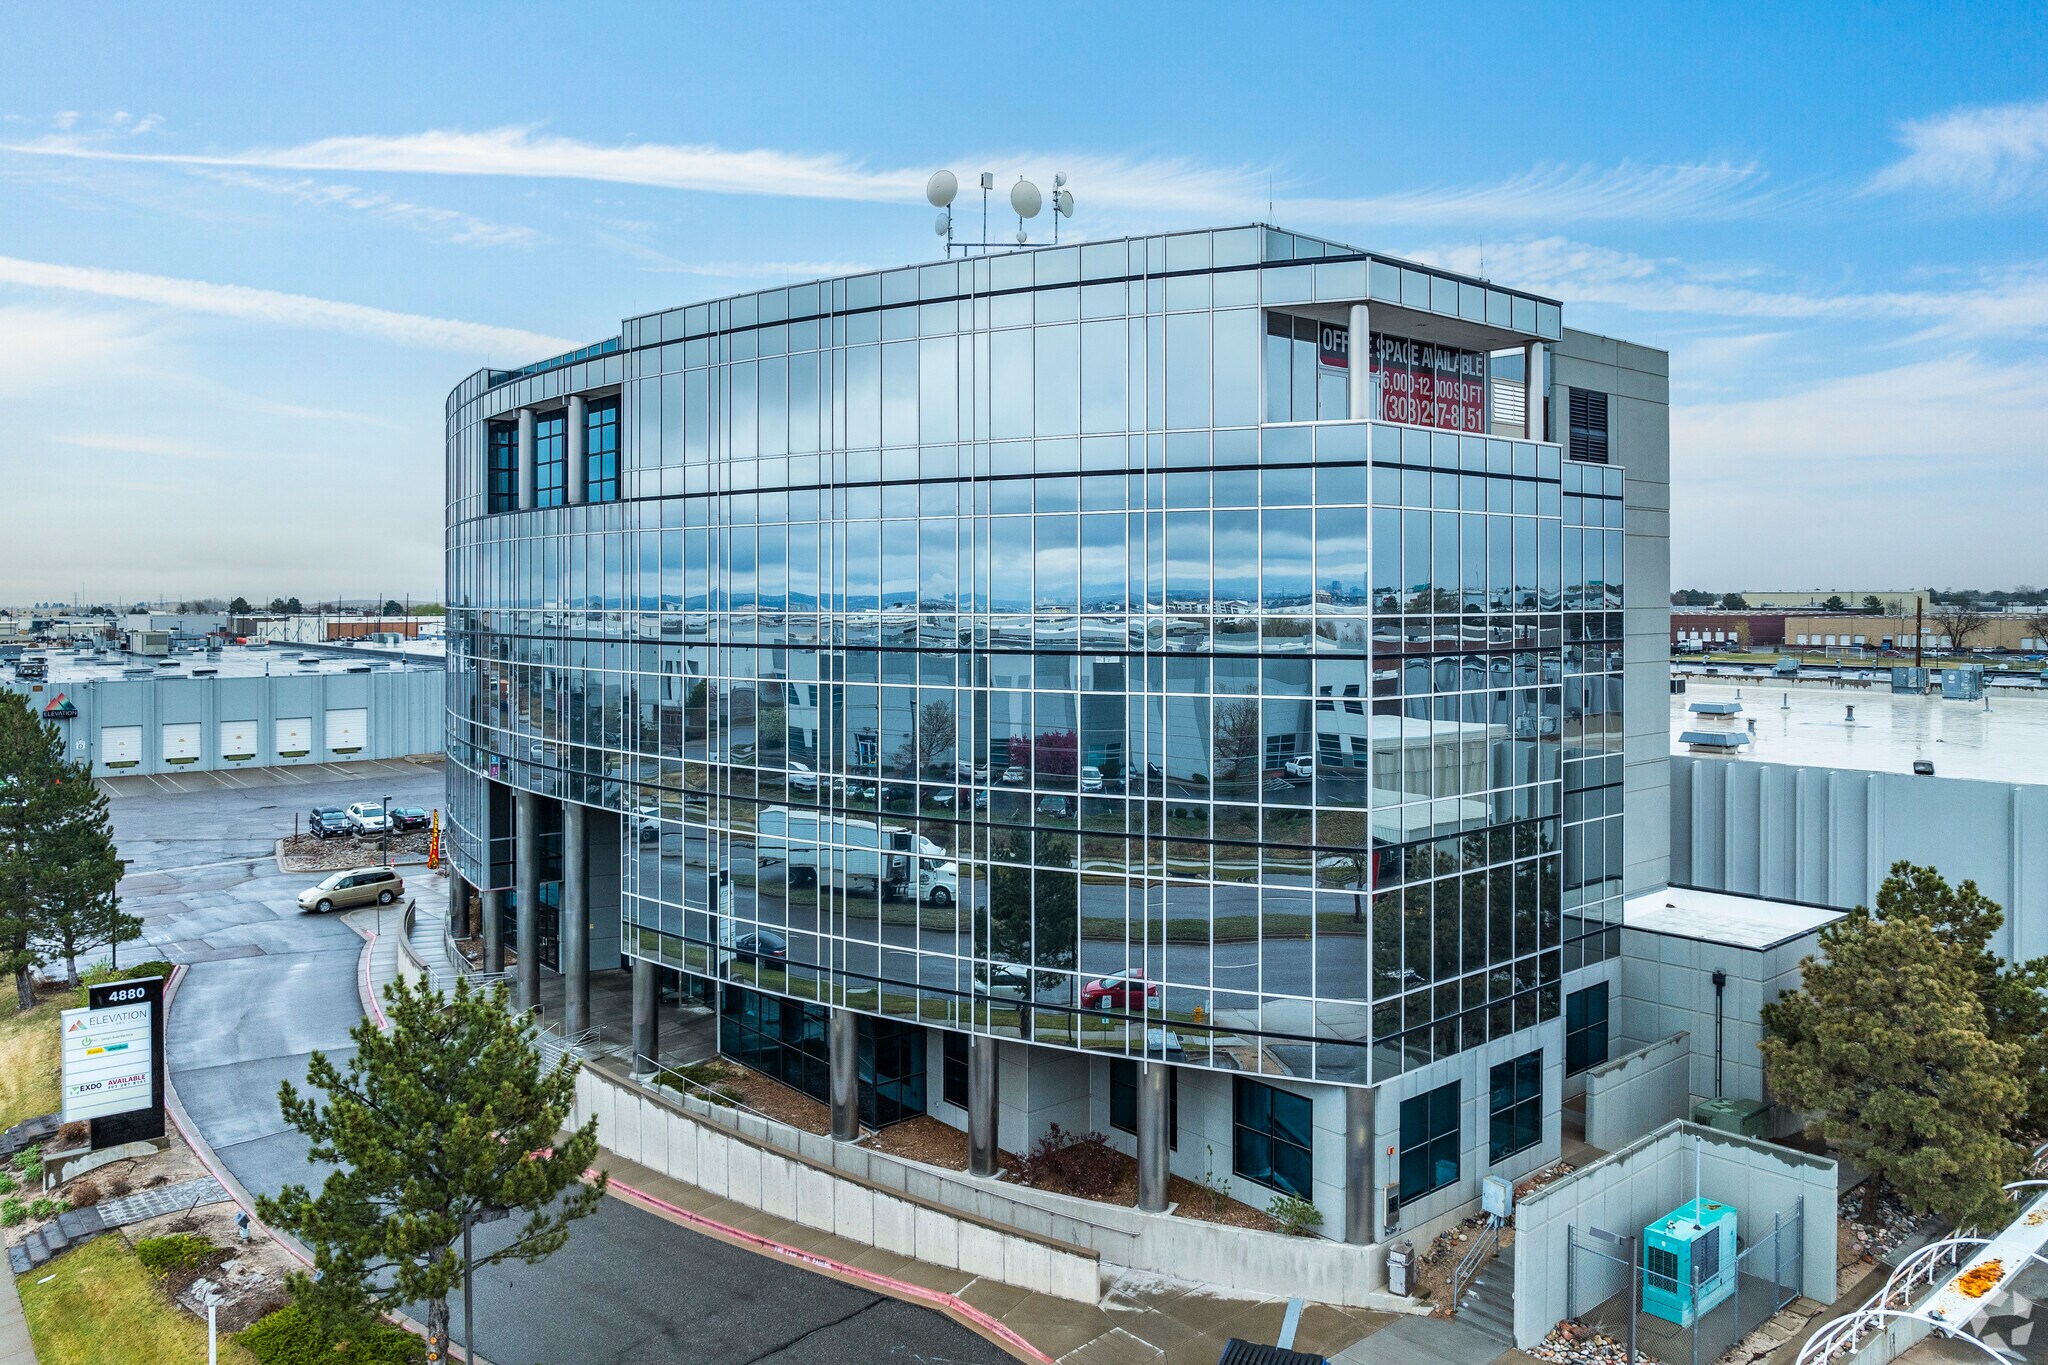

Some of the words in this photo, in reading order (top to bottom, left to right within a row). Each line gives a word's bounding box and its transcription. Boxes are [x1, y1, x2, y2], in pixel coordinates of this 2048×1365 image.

[1376, 338, 1419, 366] SPACE
[109, 987, 145, 1001] 4880
[90, 1010, 147, 1025] ELEVATION
[107, 1074, 146, 1086] AVAILABLE
[80, 1083, 102, 1092] EXDO
